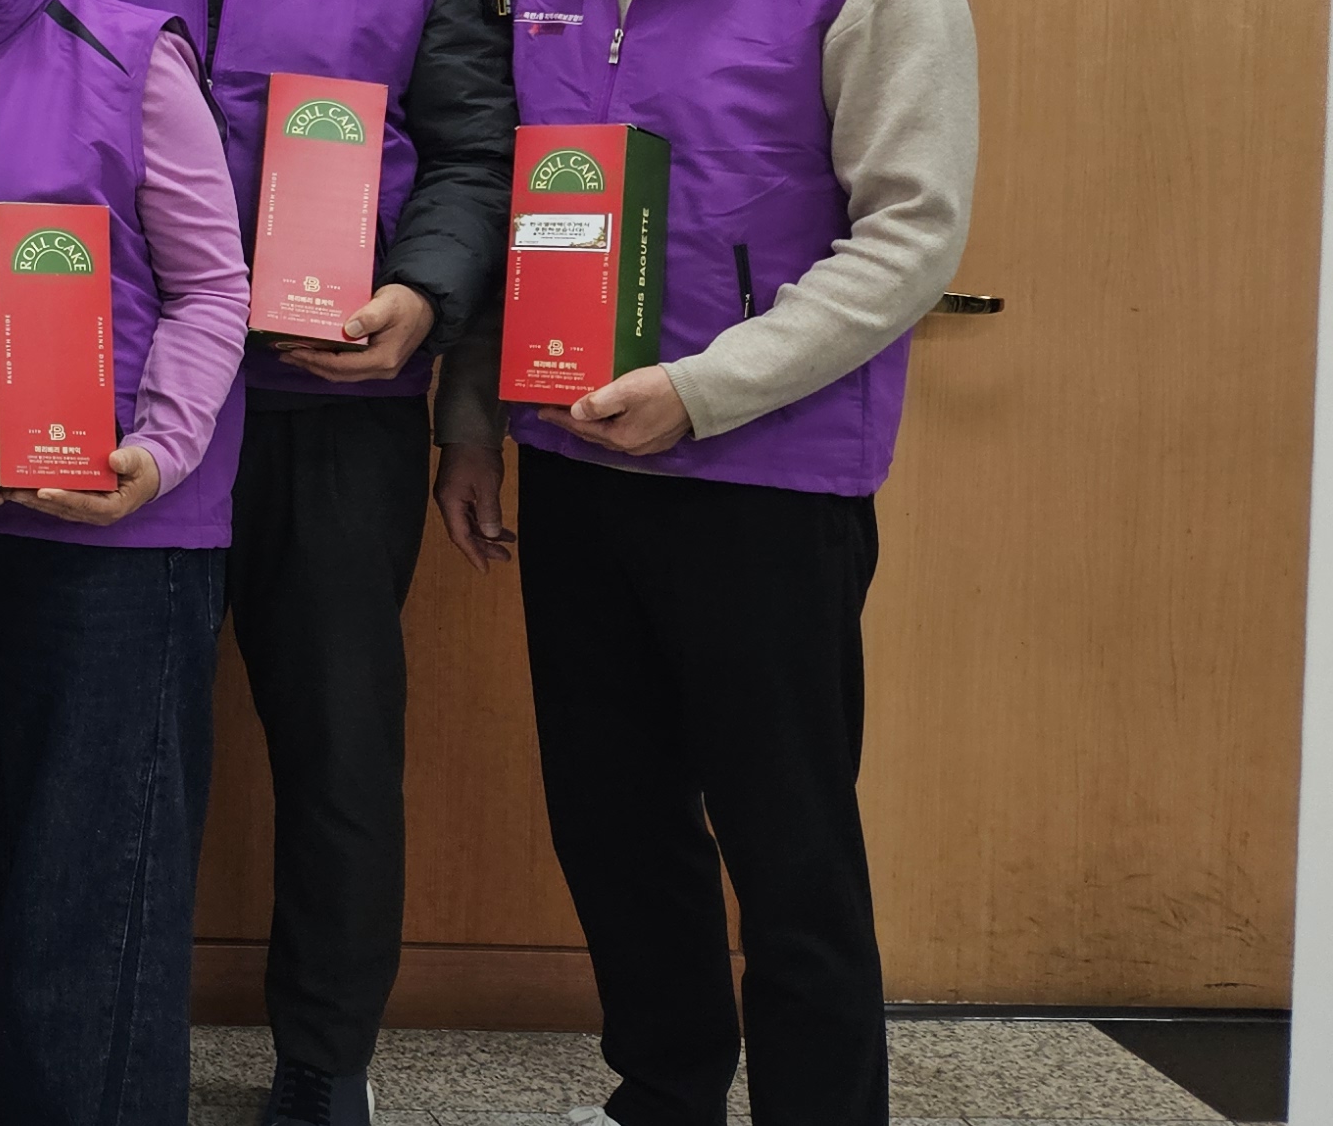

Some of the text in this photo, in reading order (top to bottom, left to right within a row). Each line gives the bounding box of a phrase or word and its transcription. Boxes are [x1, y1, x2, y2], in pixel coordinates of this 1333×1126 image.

[292, 105, 359, 141] ROLL CAKE
[535, 155, 599, 191] ROLL CAKE
[20, 236, 87, 271] ROLL CAKE
[635, 207, 650, 337] PARIS BAGUETTE
